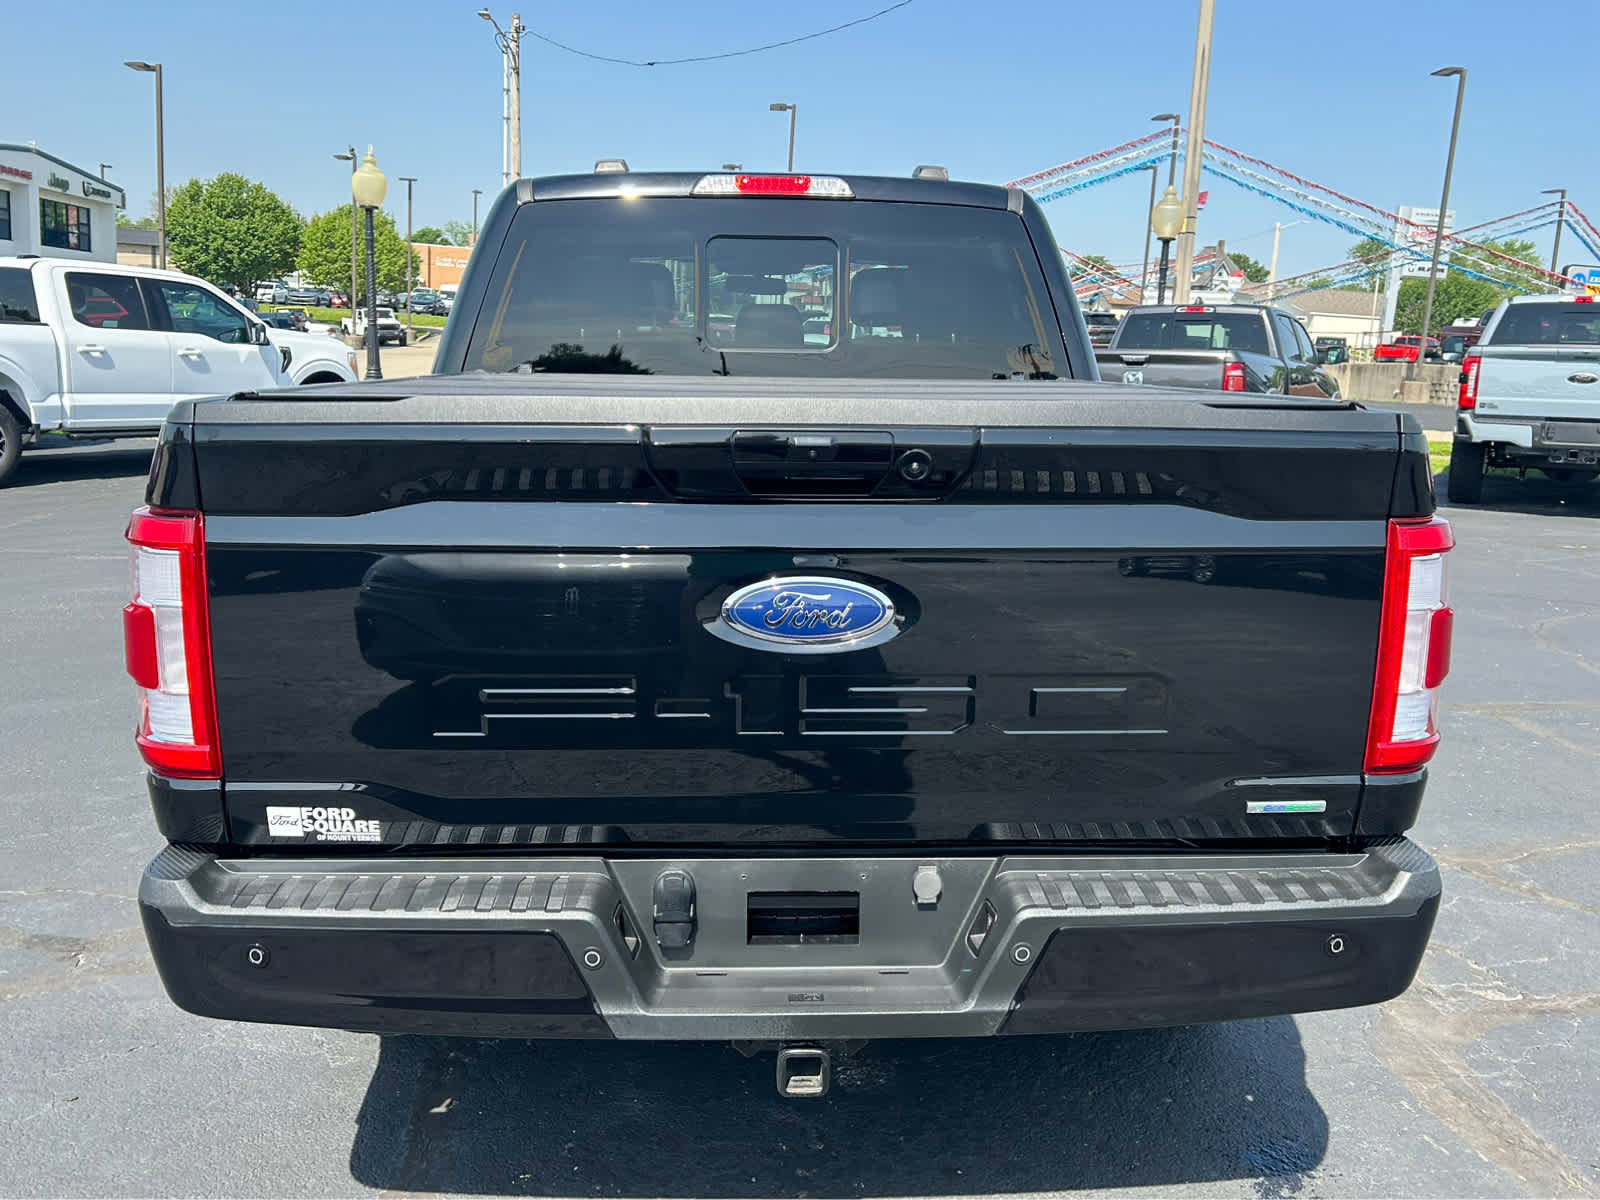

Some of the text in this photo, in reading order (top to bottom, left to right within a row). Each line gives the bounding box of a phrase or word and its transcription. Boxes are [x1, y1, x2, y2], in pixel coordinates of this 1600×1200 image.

[764, 591, 854, 628] Ford
[432, 673, 1170, 736] F-150
[301, 807, 355, 820] FORD
[270, 815, 299, 826] Ford
[303, 820, 380, 833] SQUARE
